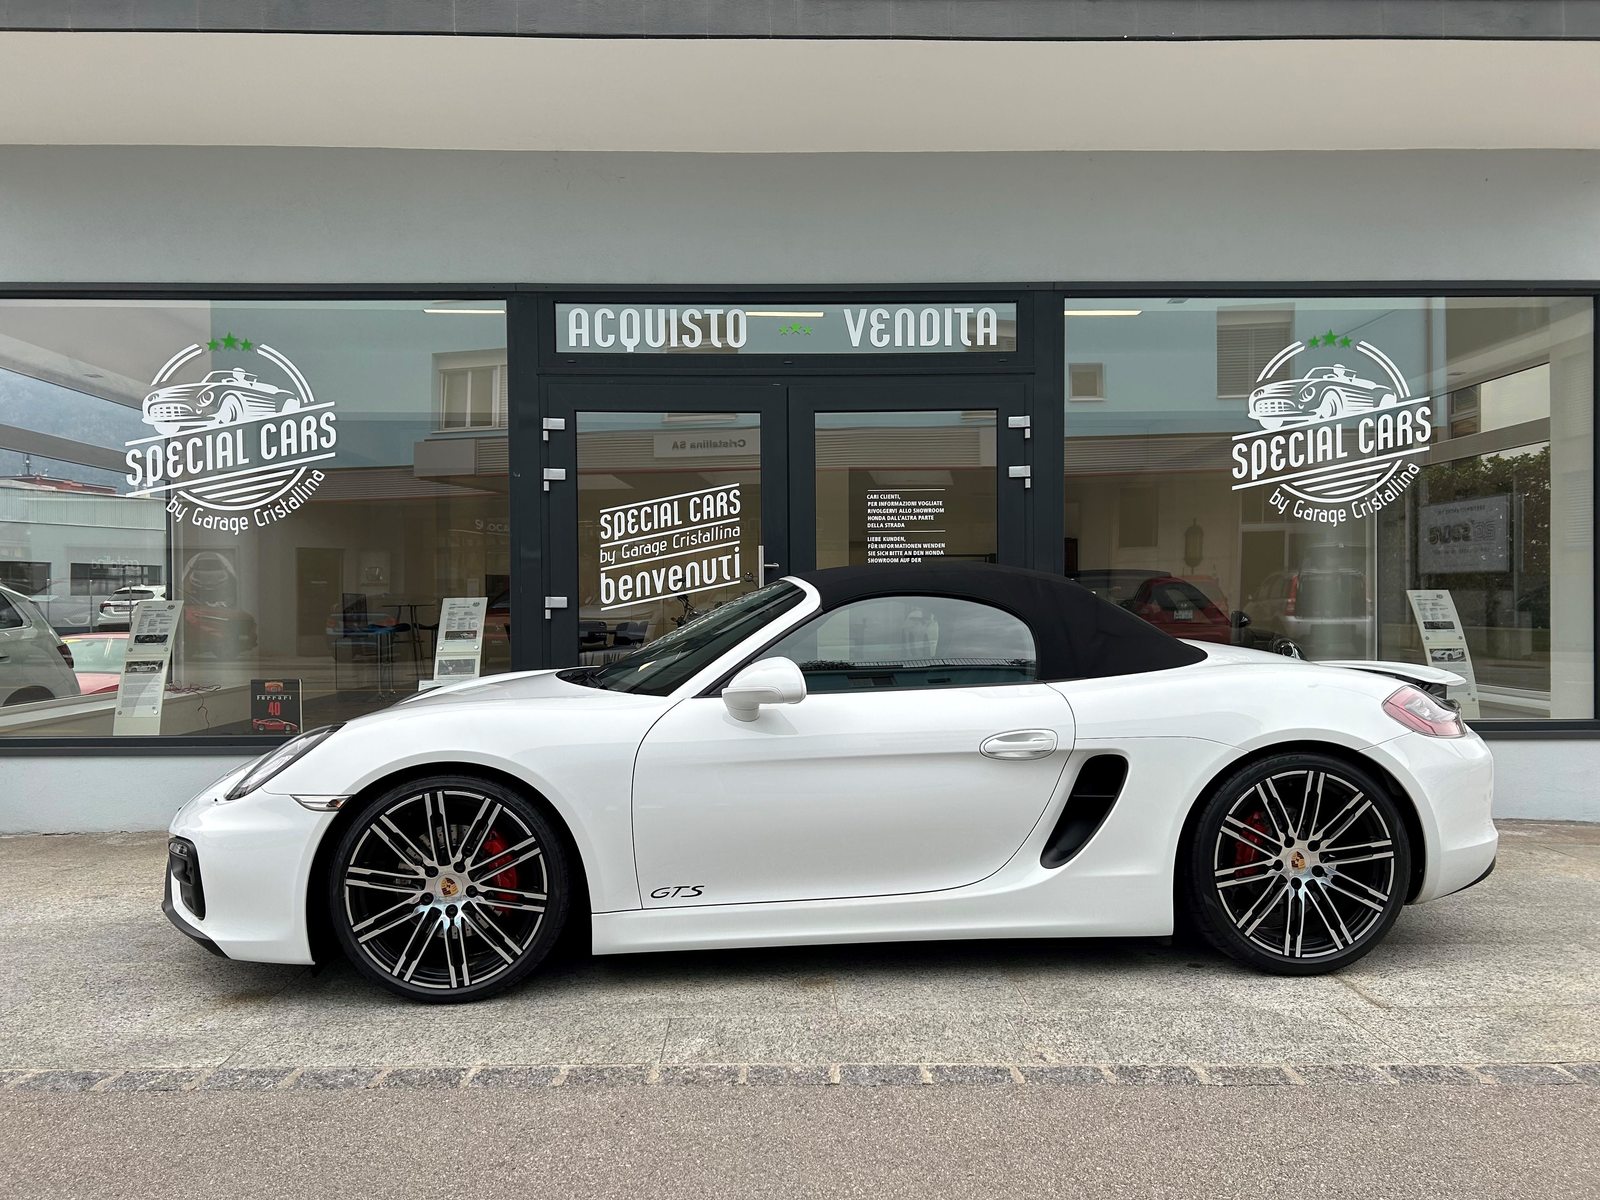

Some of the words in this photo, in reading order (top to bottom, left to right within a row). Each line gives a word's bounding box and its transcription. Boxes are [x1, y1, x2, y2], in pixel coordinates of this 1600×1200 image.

[568, 308, 747, 352] ACQUISTO
[843, 307, 998, 347] VENDITA
[125, 429, 250, 488] SPECIAL
[260, 411, 337, 460] CARS
[1232, 423, 1348, 480] SPECIAL
[1358, 406, 1431, 454] CARS
[166, 495, 188, 523] by
[192, 507, 249, 536] Garage
[253, 468, 325, 527] Cristallina
[600, 500, 682, 541] SPECIAL
[689, 489, 741, 522] CARS
[1269, 488, 1290, 515] by
[1293, 500, 1346, 527] Garage
[1351, 462, 1420, 519] Cristallina
[600, 548, 616, 564] by
[622, 540, 667, 559] Garage
[673, 525, 740, 549] Cristallina
[600, 546, 740, 604] benvenuti
[268, 701, 281, 716] 40
[650, 885, 705, 899] GTS
